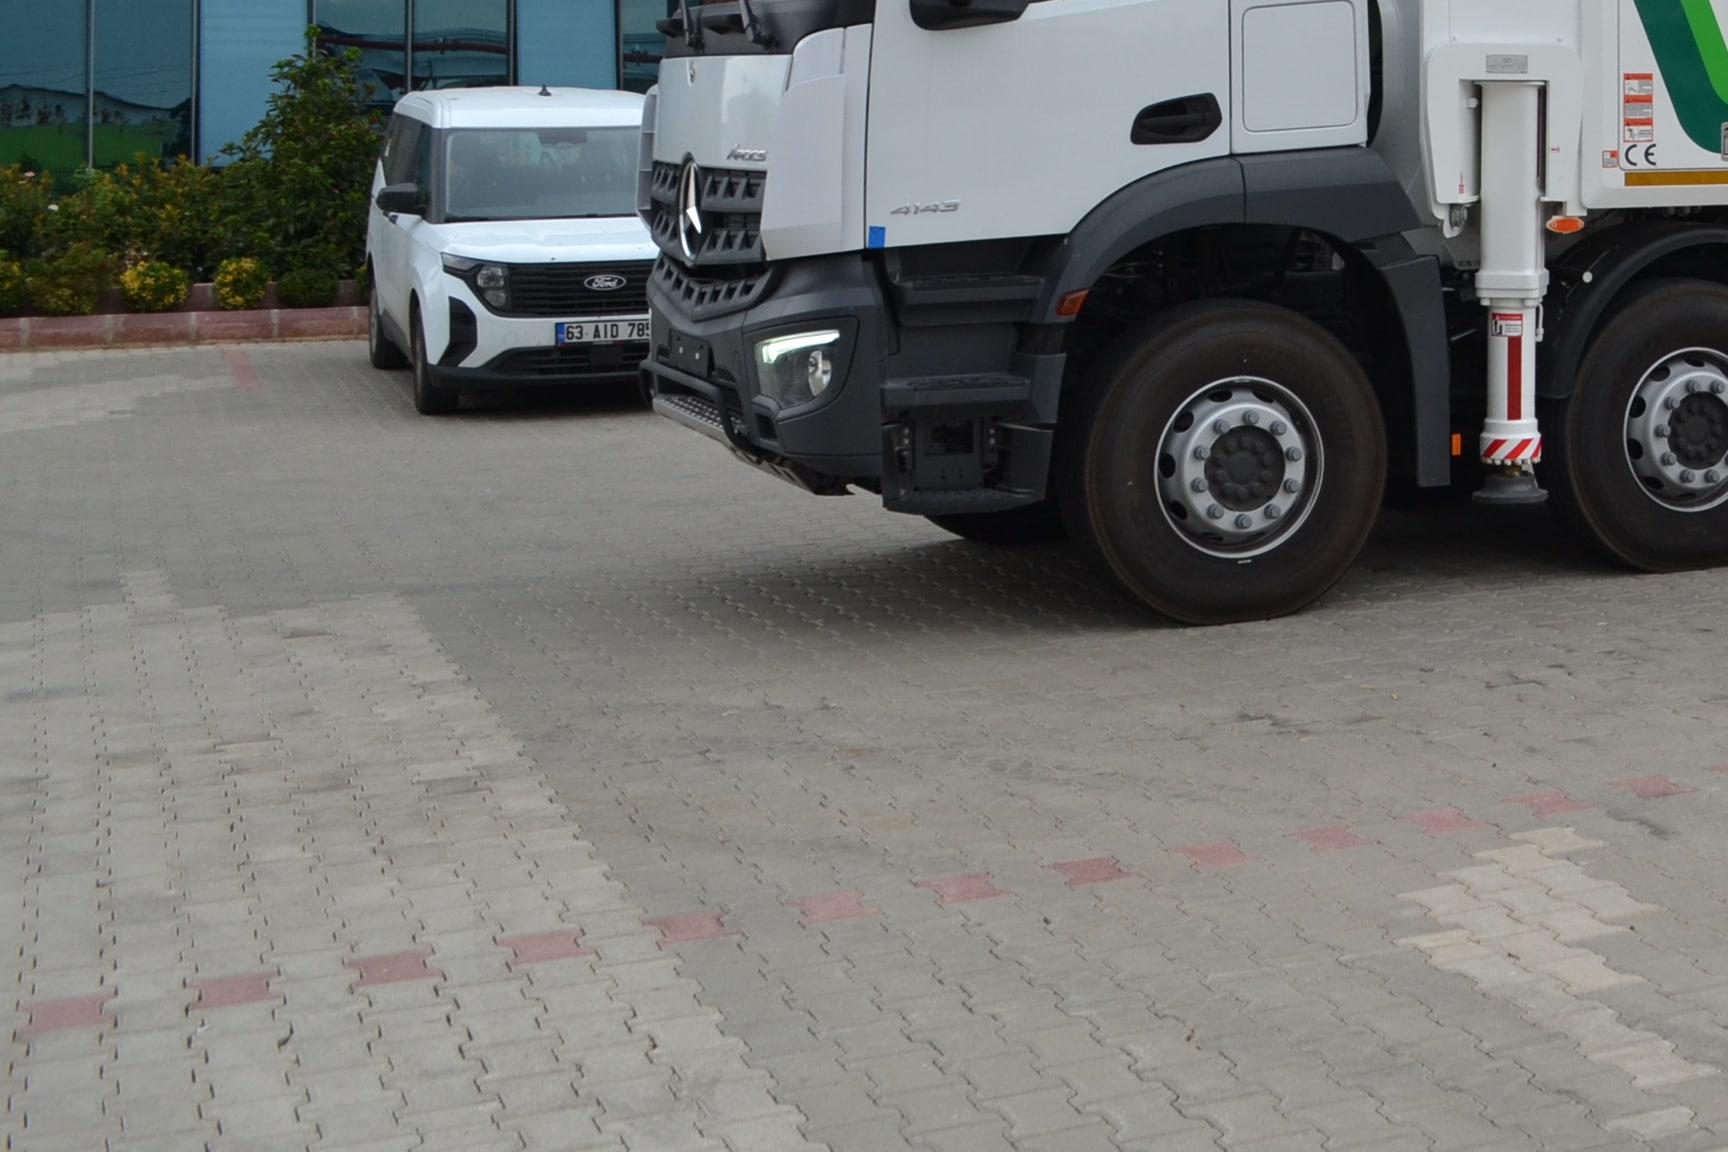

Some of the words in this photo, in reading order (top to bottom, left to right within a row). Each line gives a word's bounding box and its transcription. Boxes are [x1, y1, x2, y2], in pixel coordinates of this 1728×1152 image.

[1624, 143, 1657, 167] CE
[890, 199, 960, 216] 4143
[591, 275, 618, 288] Ford
[566, 325, 584, 341] 63
[593, 323, 619, 339] AID
